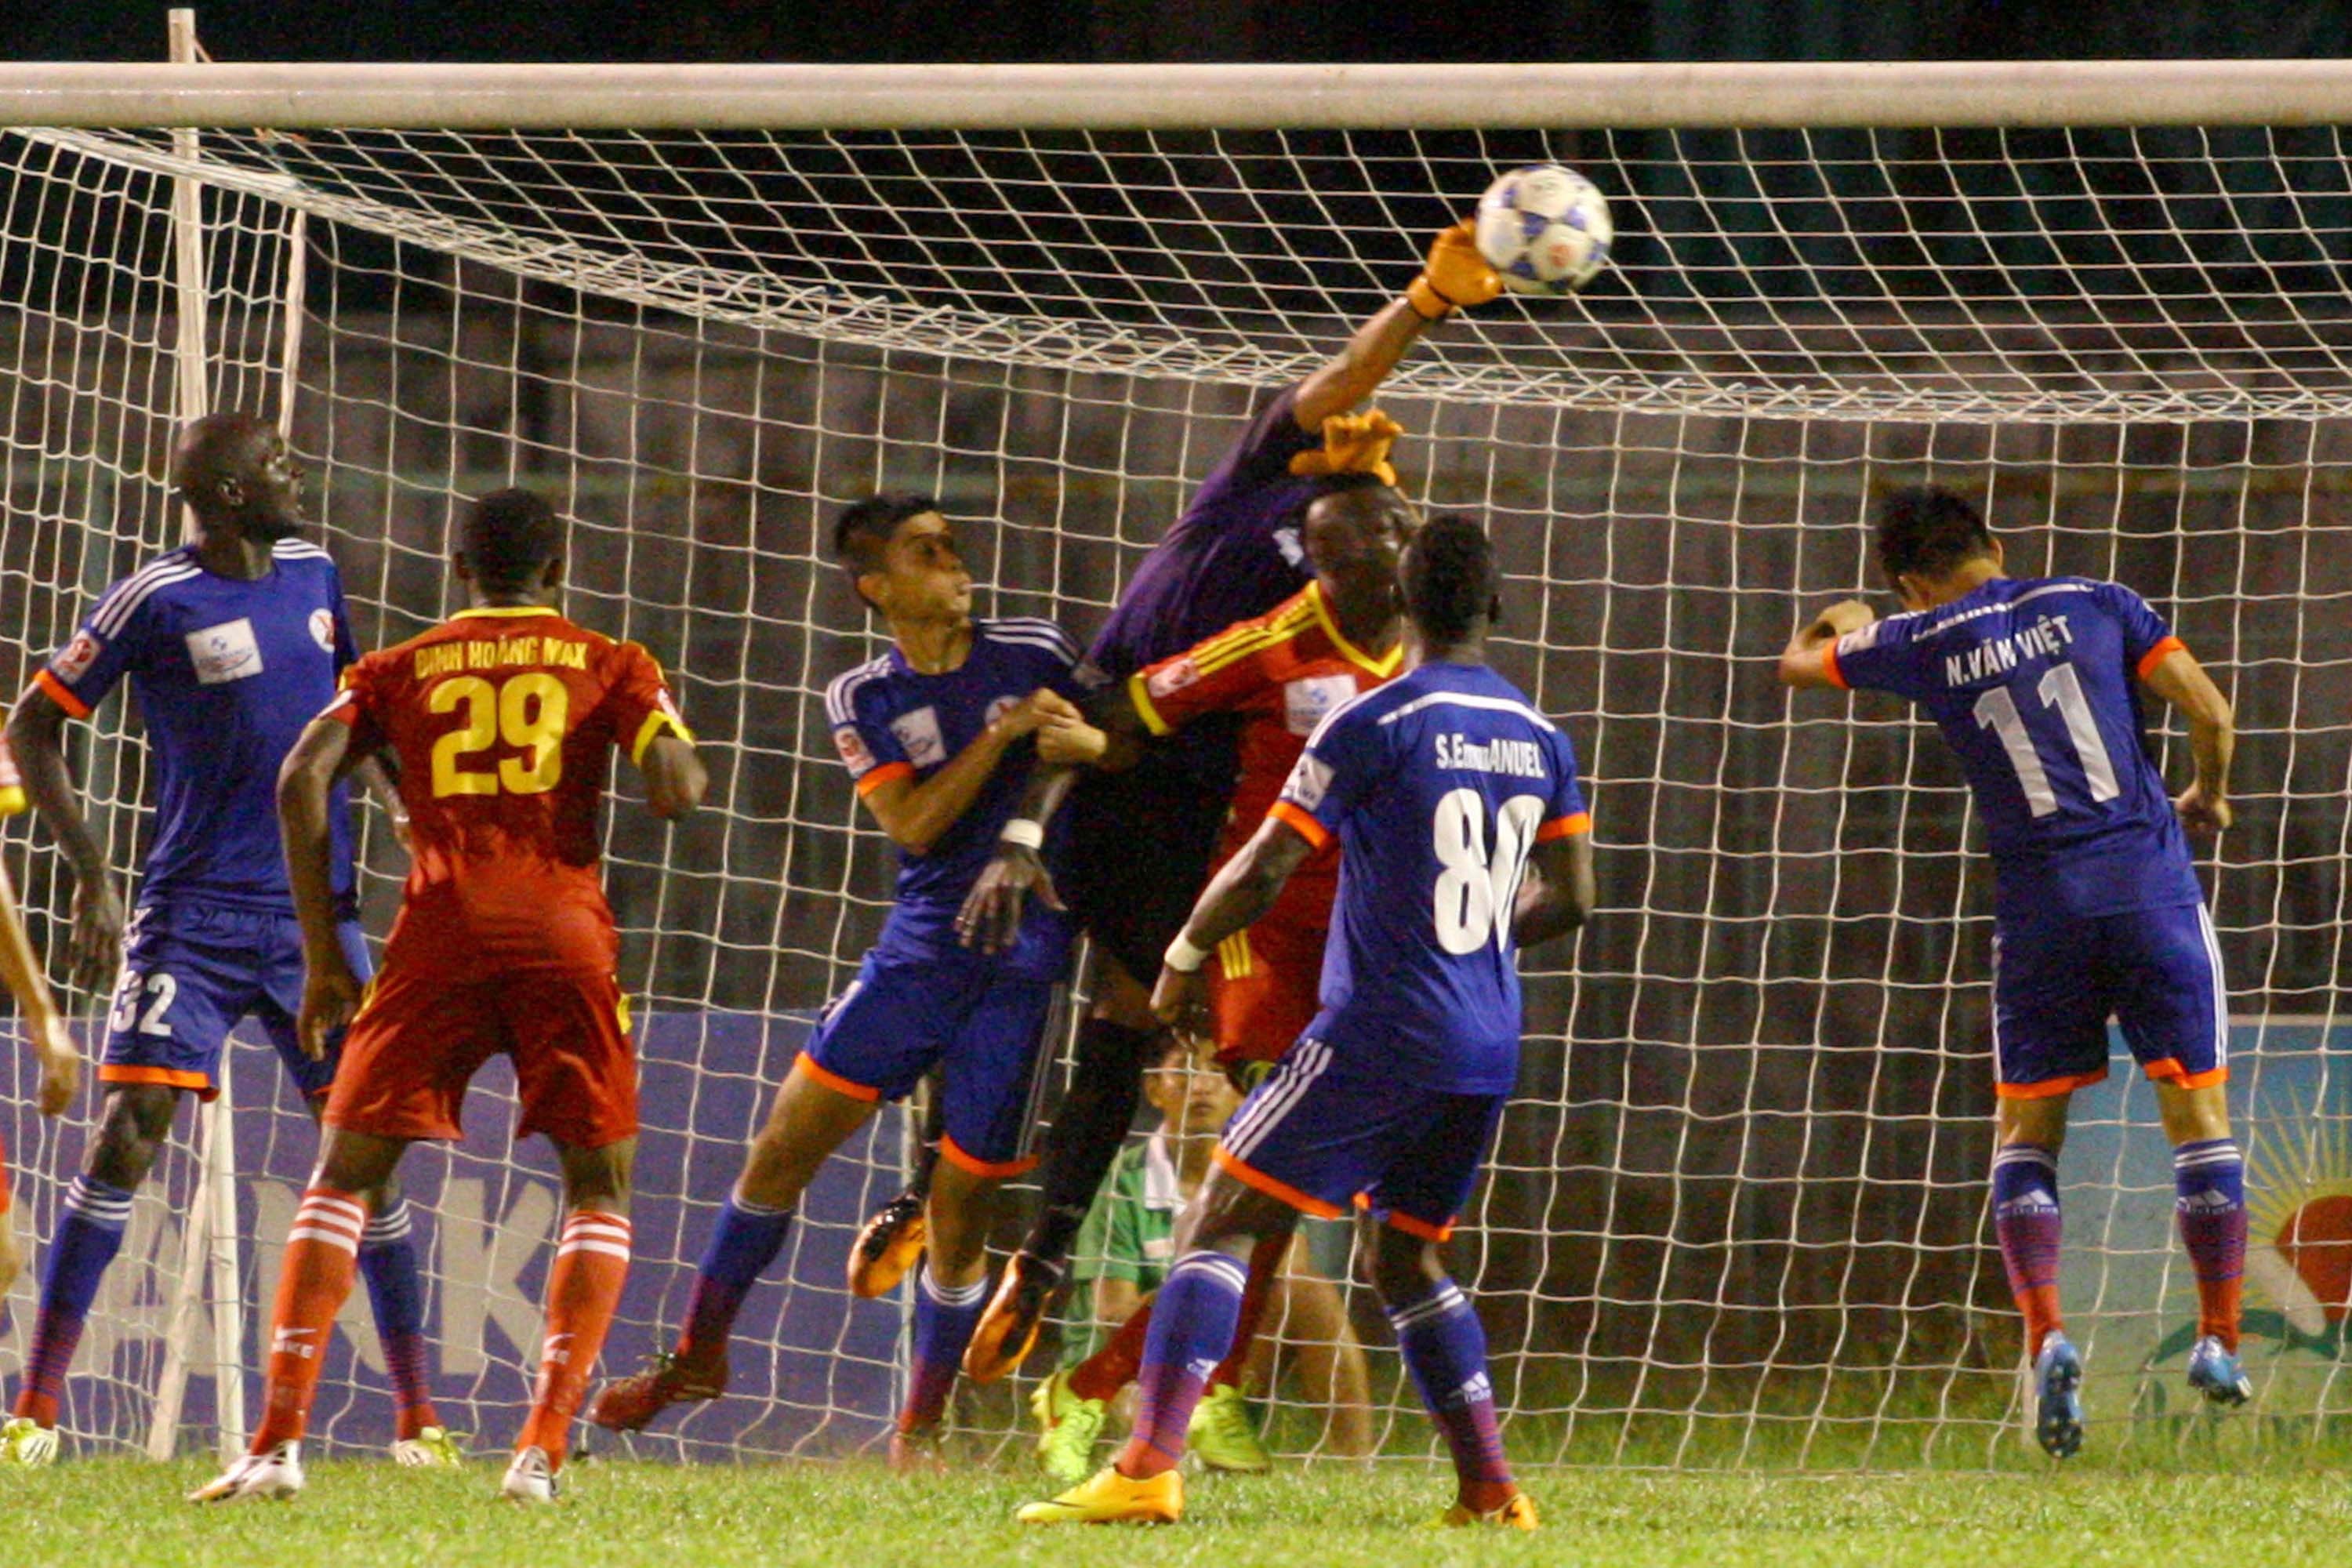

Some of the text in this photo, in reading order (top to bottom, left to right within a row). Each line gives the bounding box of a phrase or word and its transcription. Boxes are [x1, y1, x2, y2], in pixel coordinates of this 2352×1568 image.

[2014, 614, 2074, 660] VIỆT
[429, 672, 568, 799] 29
[1973, 662, 2120, 818] 11
[111, 970, 177, 1037] 32
